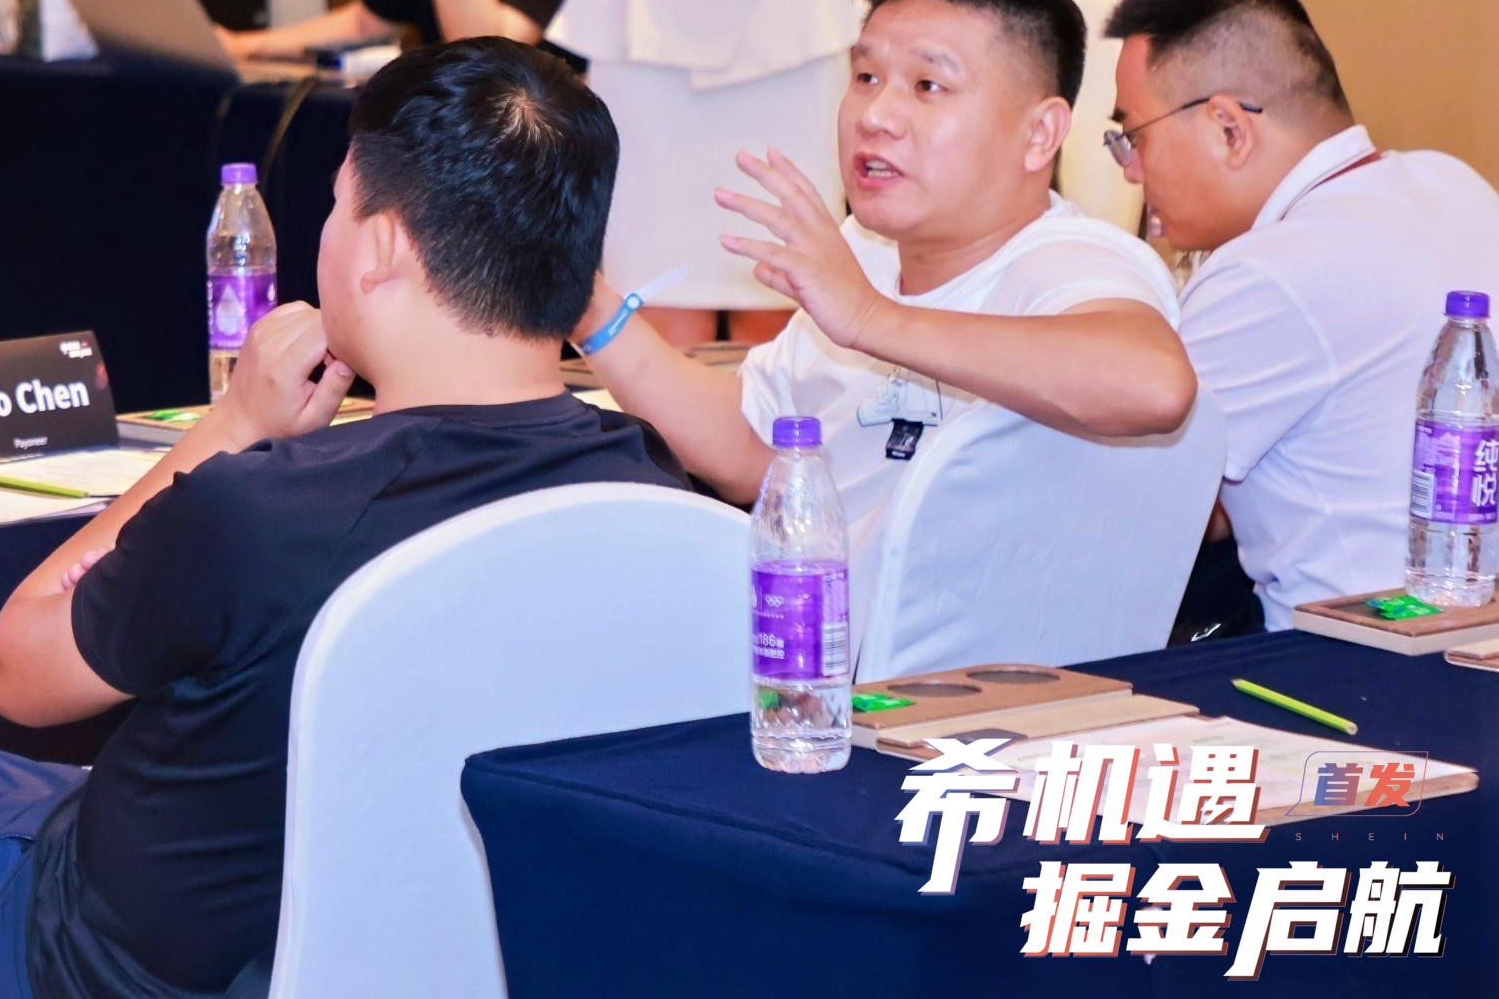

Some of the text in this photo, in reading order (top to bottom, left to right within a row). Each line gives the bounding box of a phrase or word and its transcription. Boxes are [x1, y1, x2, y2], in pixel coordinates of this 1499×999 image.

[16, 379, 90, 414] Chen
[13, 436, 48, 450] Payoneer
[1472, 439, 1499, 507] 纯悦
